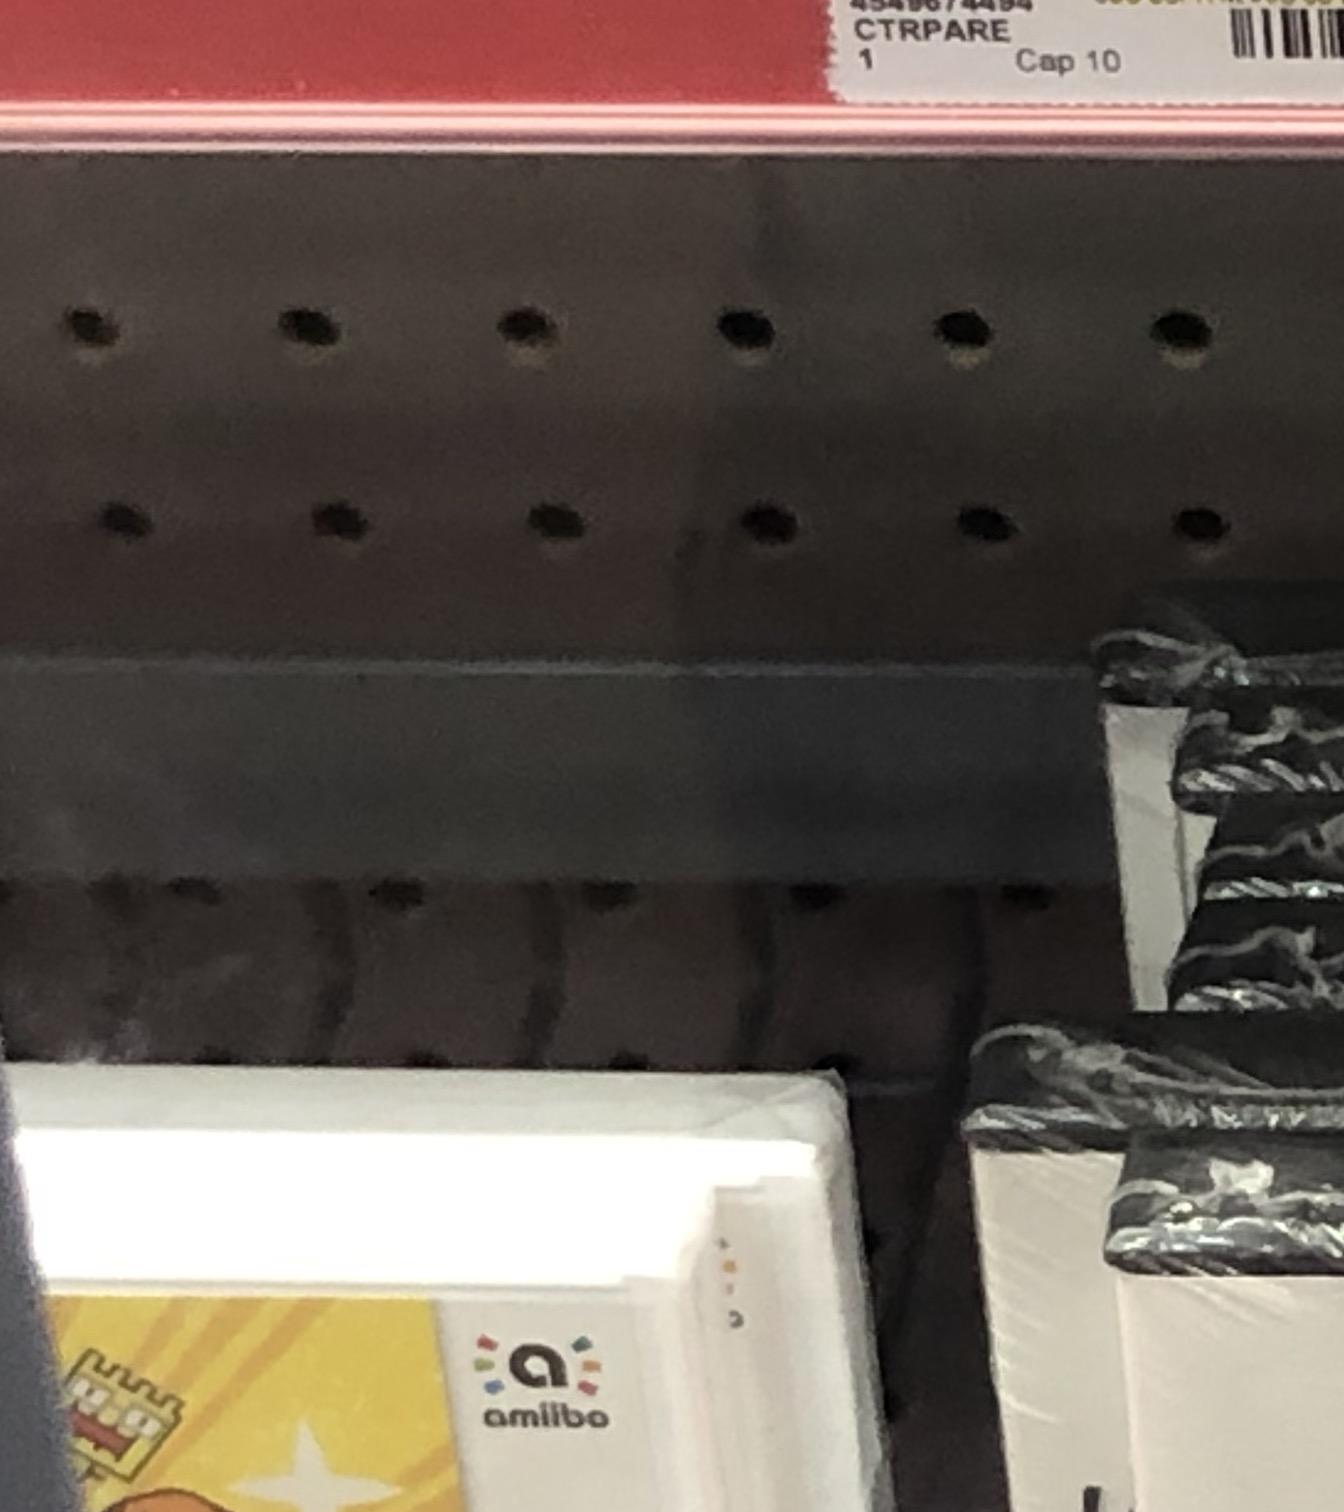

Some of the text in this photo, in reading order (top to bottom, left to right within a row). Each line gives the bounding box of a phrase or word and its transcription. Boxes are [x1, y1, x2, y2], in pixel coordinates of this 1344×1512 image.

[854, 18, 1011, 42] CTRPARE
[859, 49, 1121, 75] 1 Cap 10
[483, 1402, 610, 1430] amiibo
